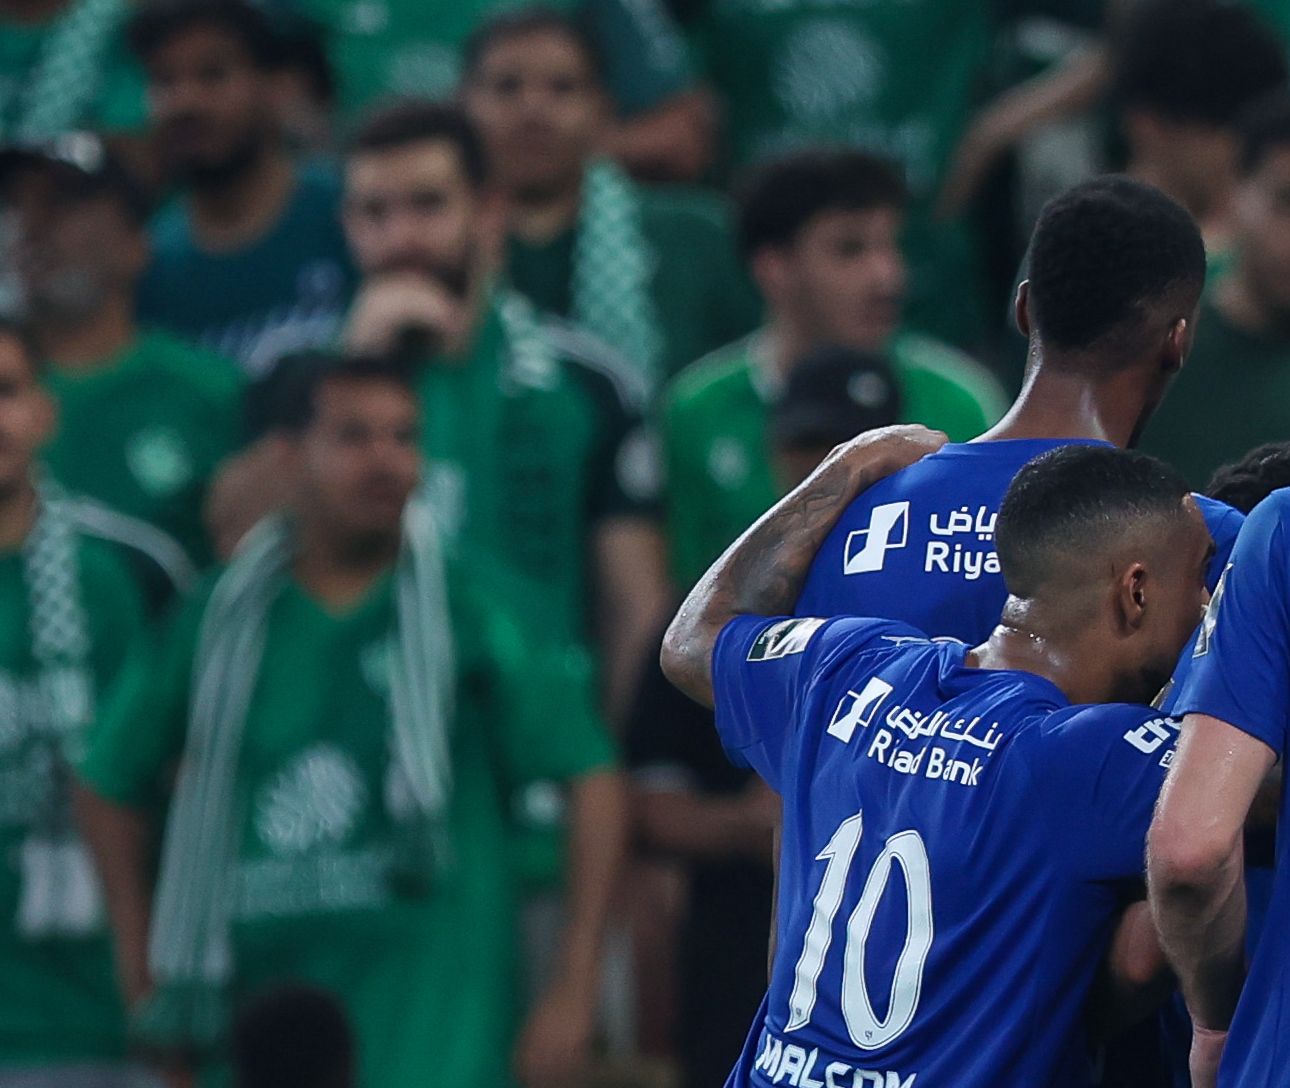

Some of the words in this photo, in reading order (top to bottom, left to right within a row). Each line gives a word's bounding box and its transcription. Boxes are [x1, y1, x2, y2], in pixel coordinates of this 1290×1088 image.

[929, 505, 999, 541] ياض
[923, 540, 1001, 581] Riya
[866, 727, 927, 775] Riad
[925, 746, 984, 787] Bank
[783, 808, 935, 1051] 10
